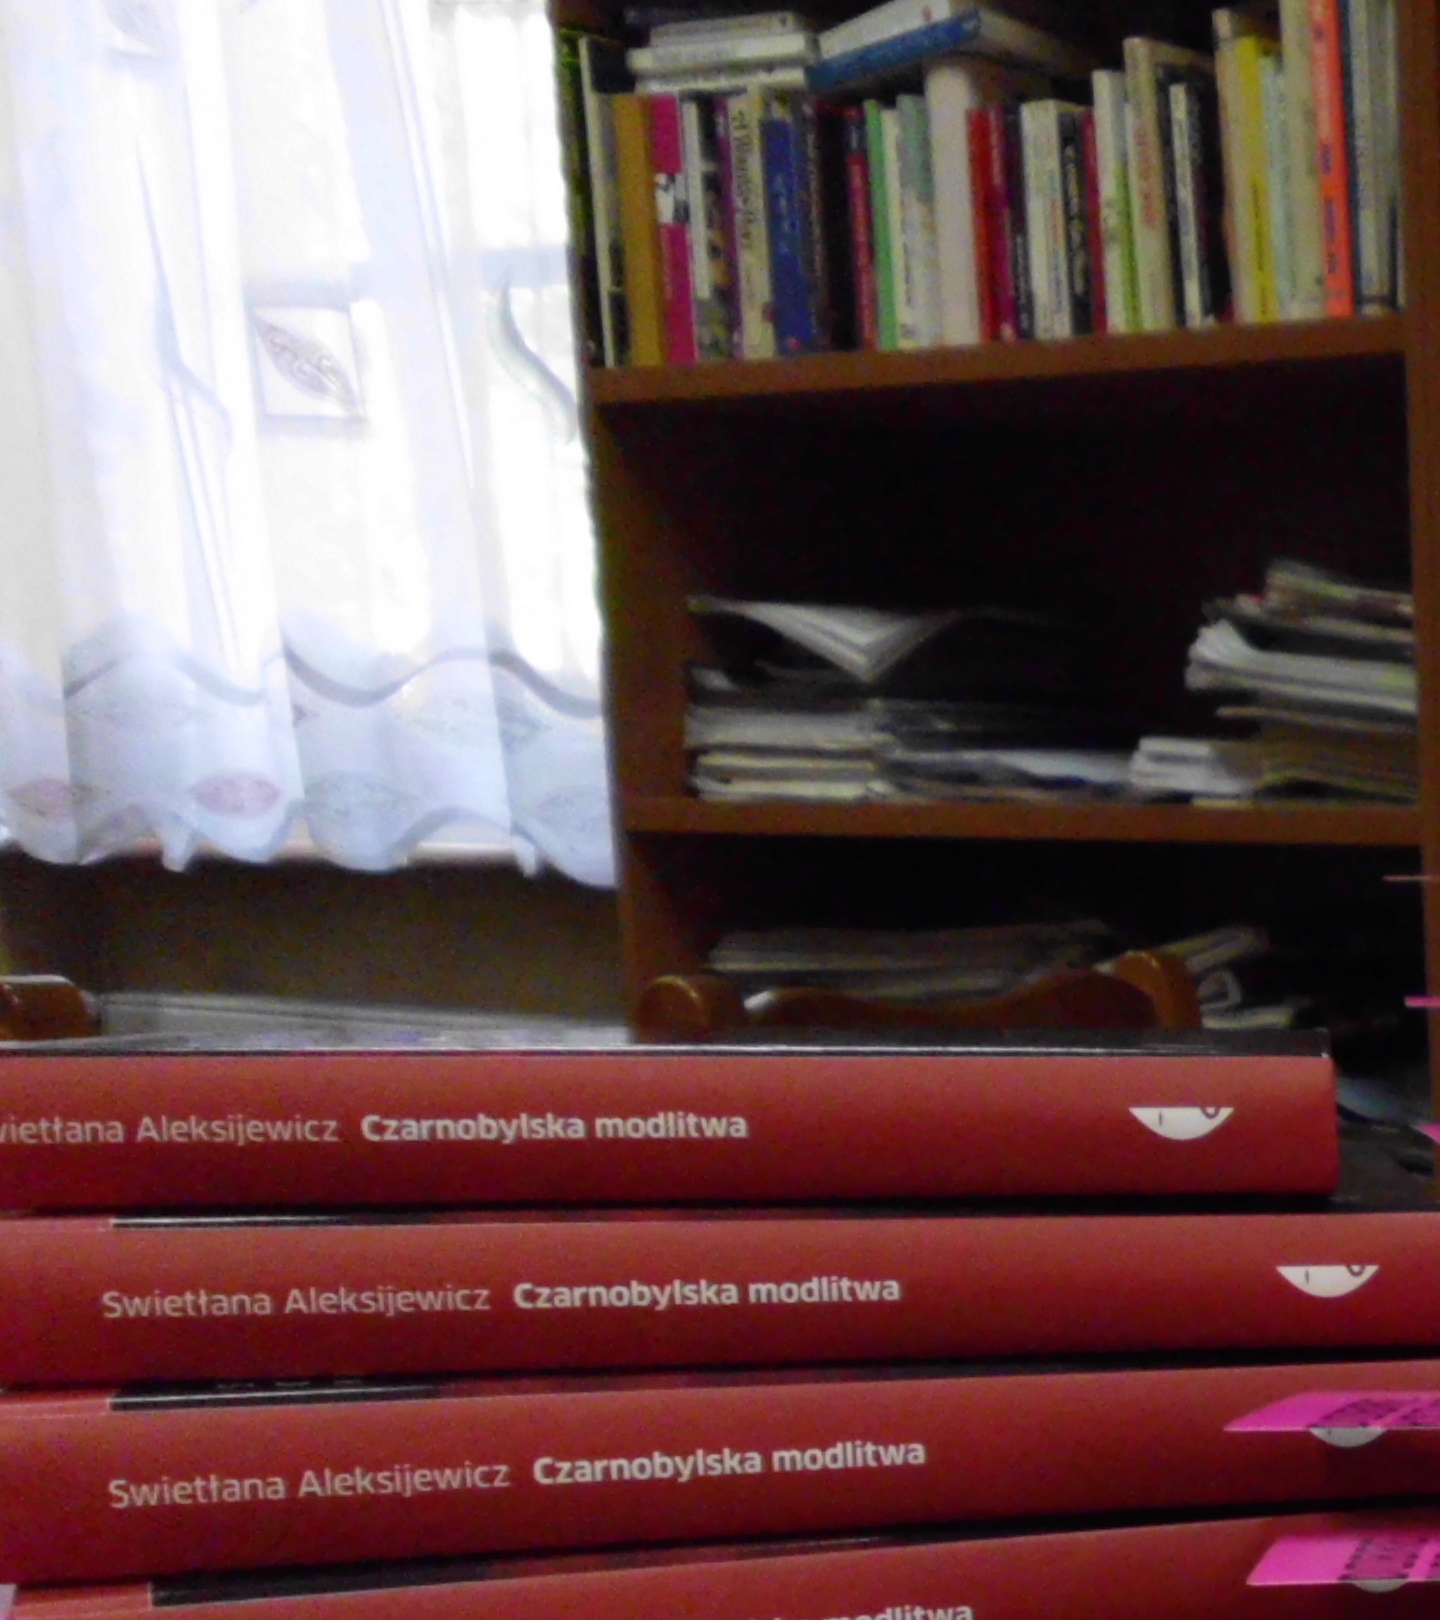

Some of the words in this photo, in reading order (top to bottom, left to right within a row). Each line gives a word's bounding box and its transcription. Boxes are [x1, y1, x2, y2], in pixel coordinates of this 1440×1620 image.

[136, 1114, 339, 1145] Aleksijewicz
[361, 1111, 586, 1144] Czarnobylska
[595, 1111, 749, 1140] modlitwa
[102, 1288, 272, 1318] Swietłana
[284, 1283, 491, 1317] Aleksijewicz
[512, 1277, 739, 1311] Czarnobylska
[748, 1274, 902, 1305] modlitwa
[108, 1472, 287, 1511] Swietłana
[298, 1460, 511, 1499] Aleksijewicz
[532, 1446, 763, 1486] Czarnobylska
[772, 1438, 927, 1474] modlitwa
